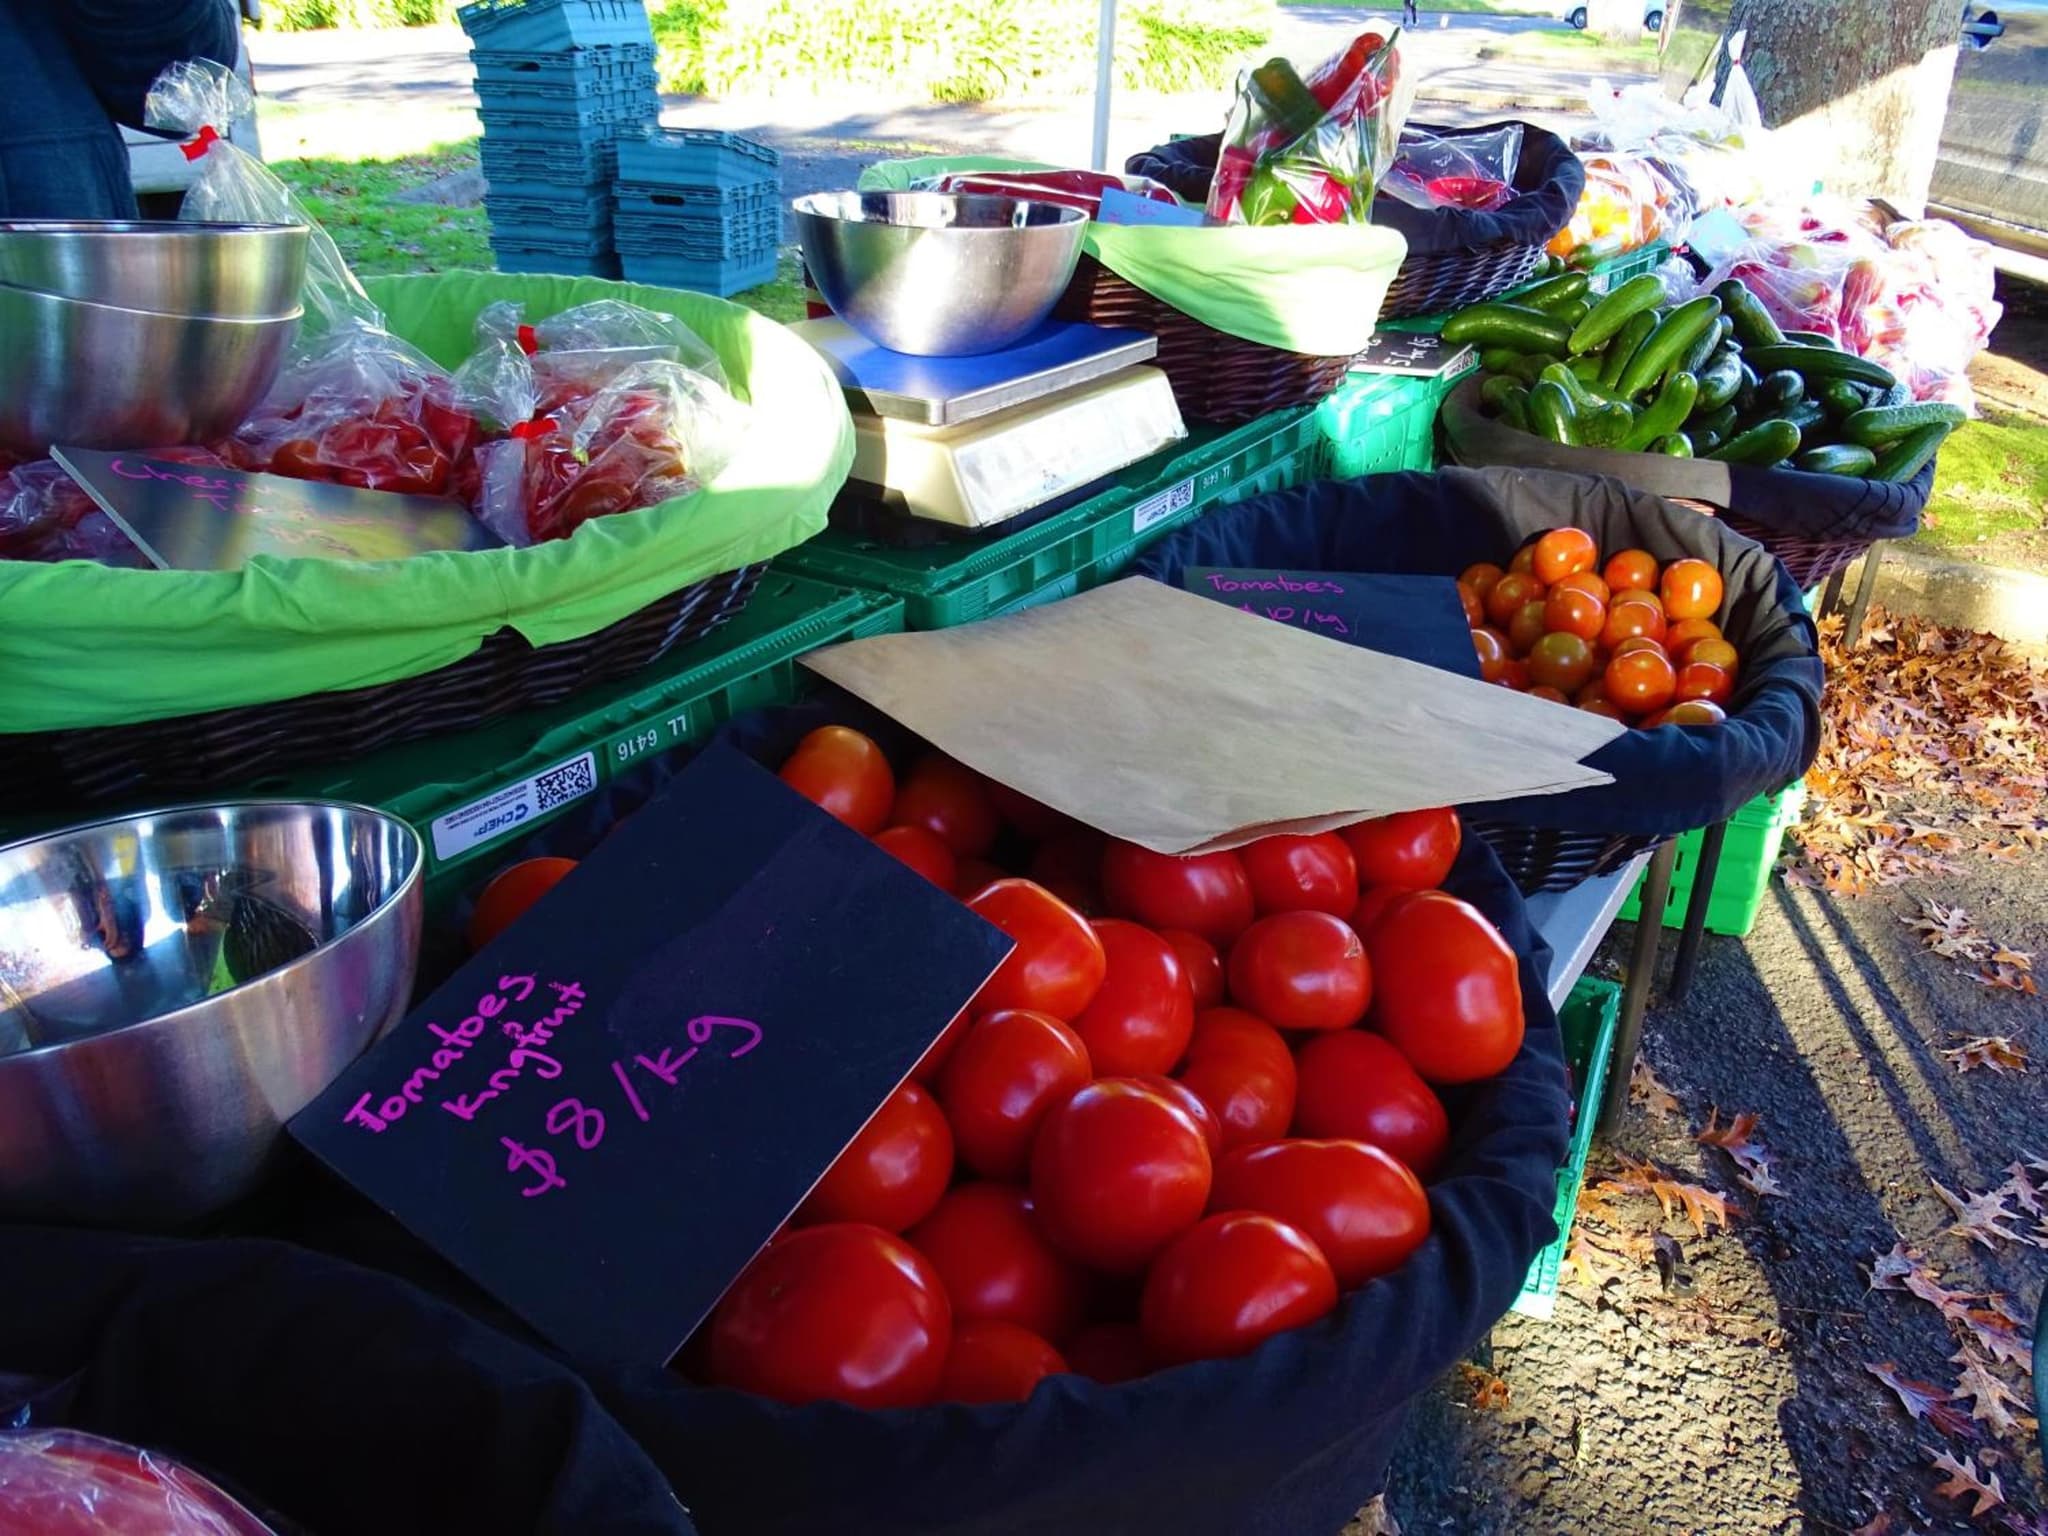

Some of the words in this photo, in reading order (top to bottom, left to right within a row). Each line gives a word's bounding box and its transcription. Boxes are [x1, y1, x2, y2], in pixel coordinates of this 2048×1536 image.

[1207, 574, 1344, 594] Tomatoes
[667, 714, 688, 737] LL
[617, 728, 658, 761] 6416
[344, 973, 537, 1134] Tomatoes
